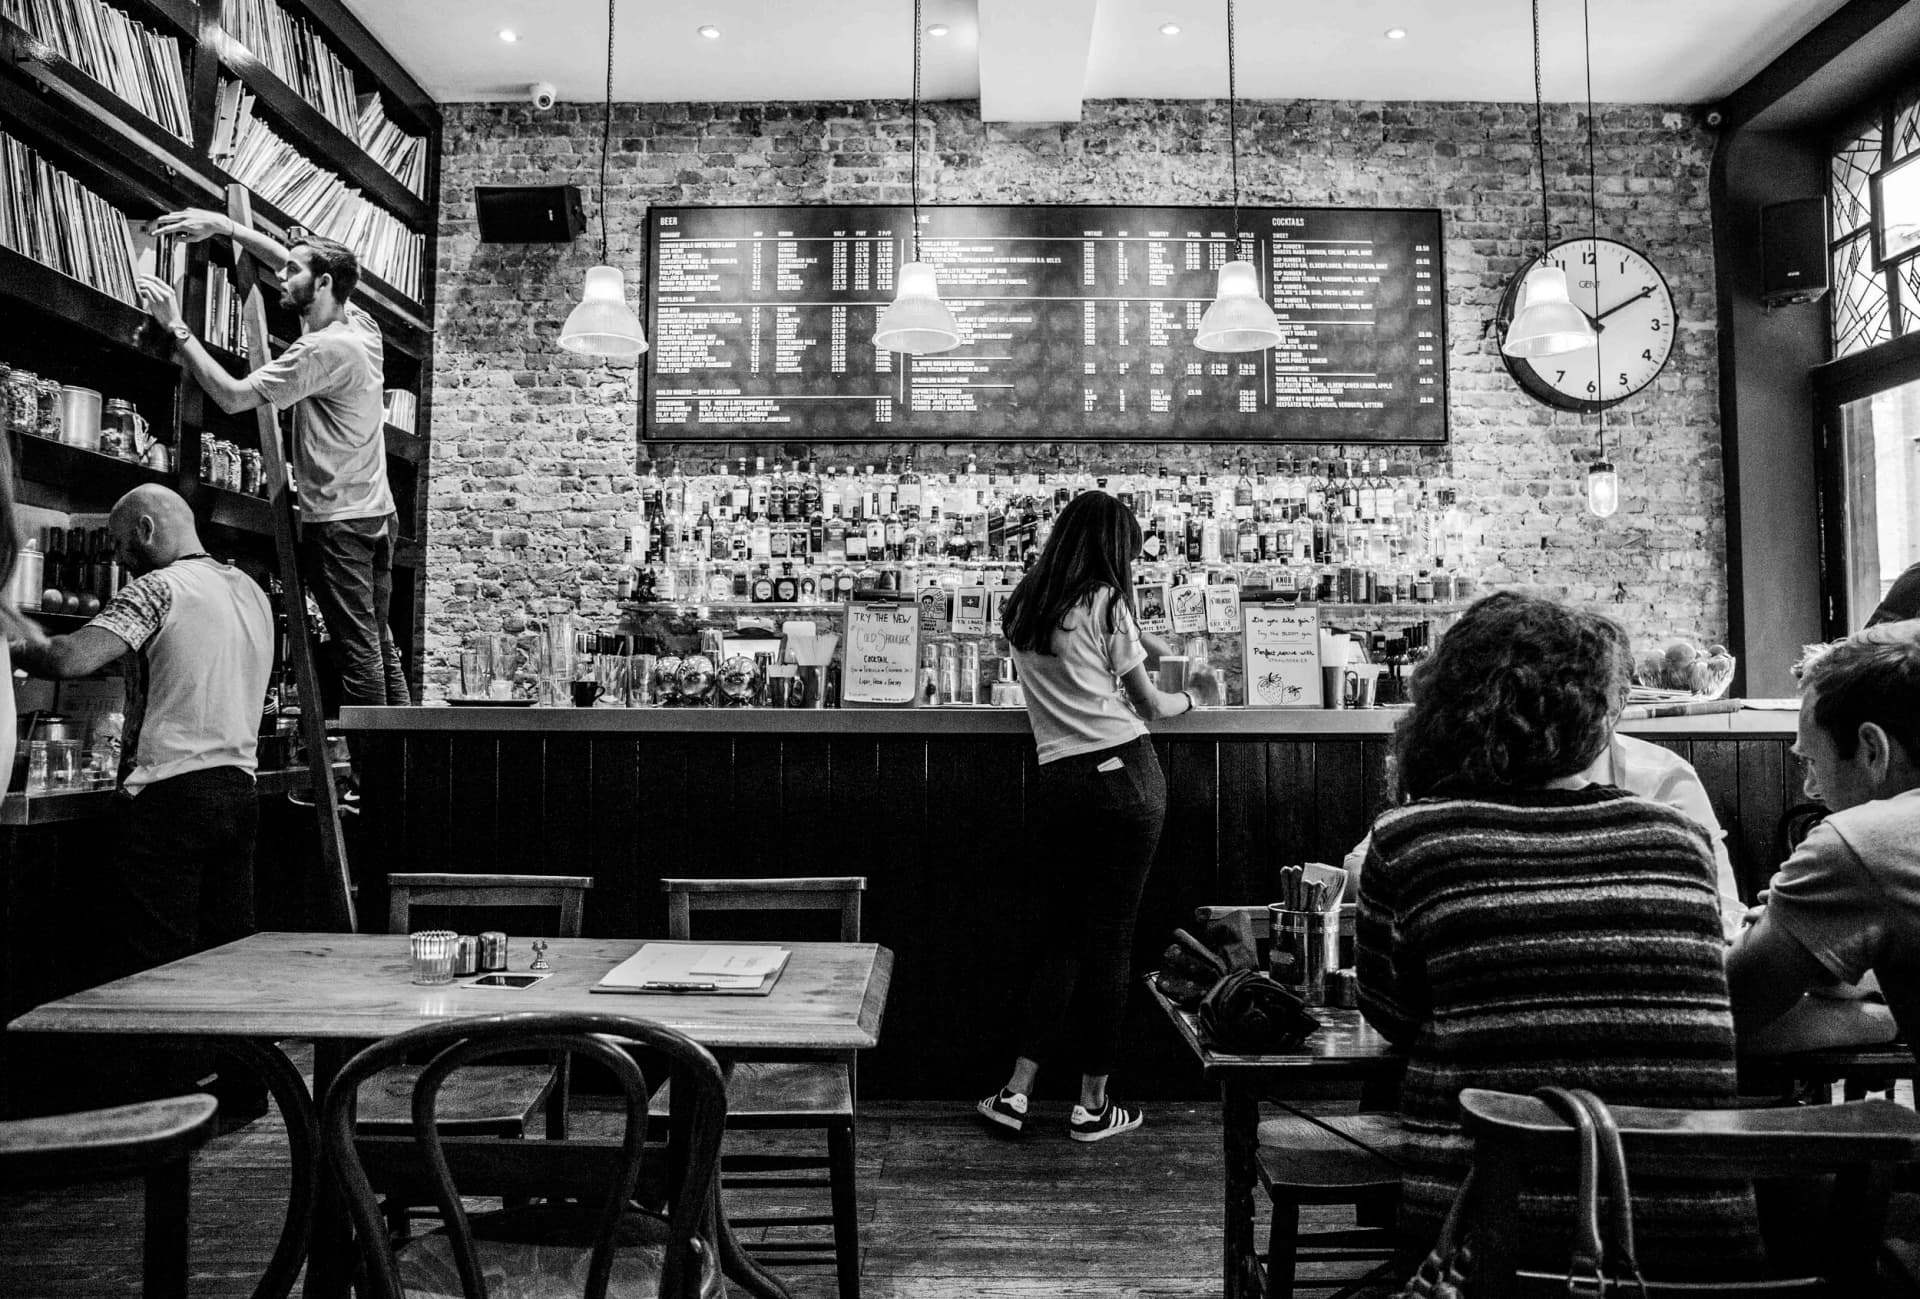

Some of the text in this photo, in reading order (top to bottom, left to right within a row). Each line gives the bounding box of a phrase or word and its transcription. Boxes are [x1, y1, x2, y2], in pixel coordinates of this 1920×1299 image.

[1272, 218, 1304, 226] COCKTAILS
[1583, 253, 1596, 265] 12
[1642, 287, 1651, 298] 2
[1651, 319, 1660, 330] 3
[1642, 350, 1651, 361] 4
[1556, 371, 1566, 382] 7
[1620, 374, 1628, 385] 5
[1587, 381, 1596, 392] 6
[854, 612, 871, 623] TRY
[875, 613, 888, 622] THE
[893, 615, 911, 624] NEW
[1267, 619, 1278, 627] you
[1298, 616, 1315, 627] gin?
[863, 655, 889, 663] COCKTAIL
[1253, 648, 1276, 659] Perfect
